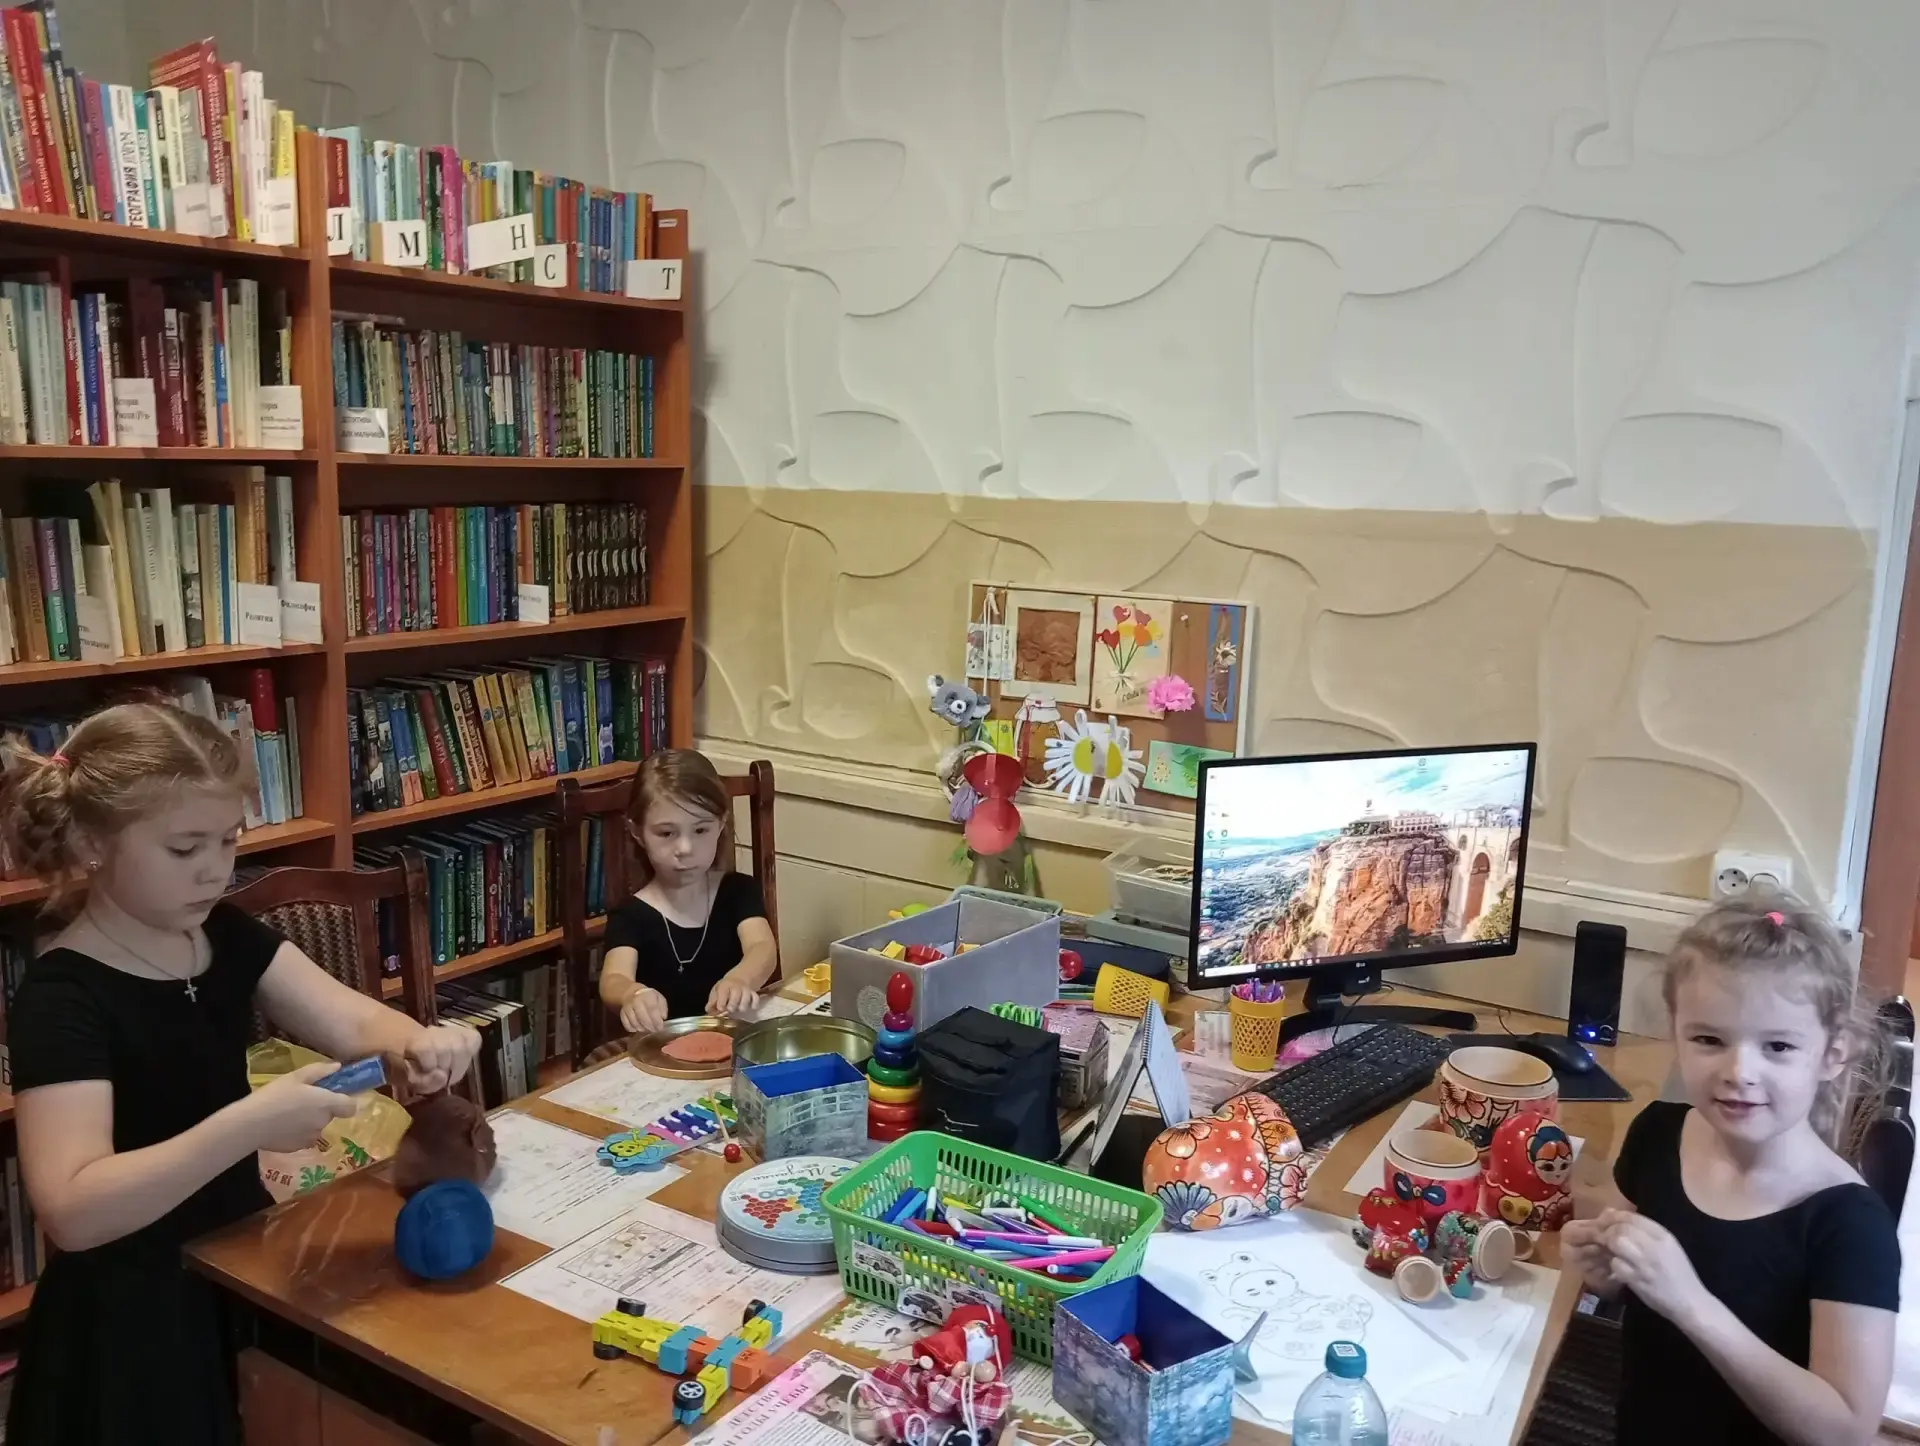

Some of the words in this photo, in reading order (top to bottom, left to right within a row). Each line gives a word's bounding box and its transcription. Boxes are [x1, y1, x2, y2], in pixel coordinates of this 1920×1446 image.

[123, 166, 144, 228] ГЕОГРАФИЯ
[327, 213, 344, 242] Л
[511, 223, 527, 251] Н
[398, 230, 421, 258] М
[544, 254, 556, 280] С
[662, 267, 676, 290] Т
[850, 1304, 883, 1333] «ПРЕКР
[728, 1389, 780, 1430] ДЕТСТВО
[733, 1413, 770, 1441] ГОДЫ
